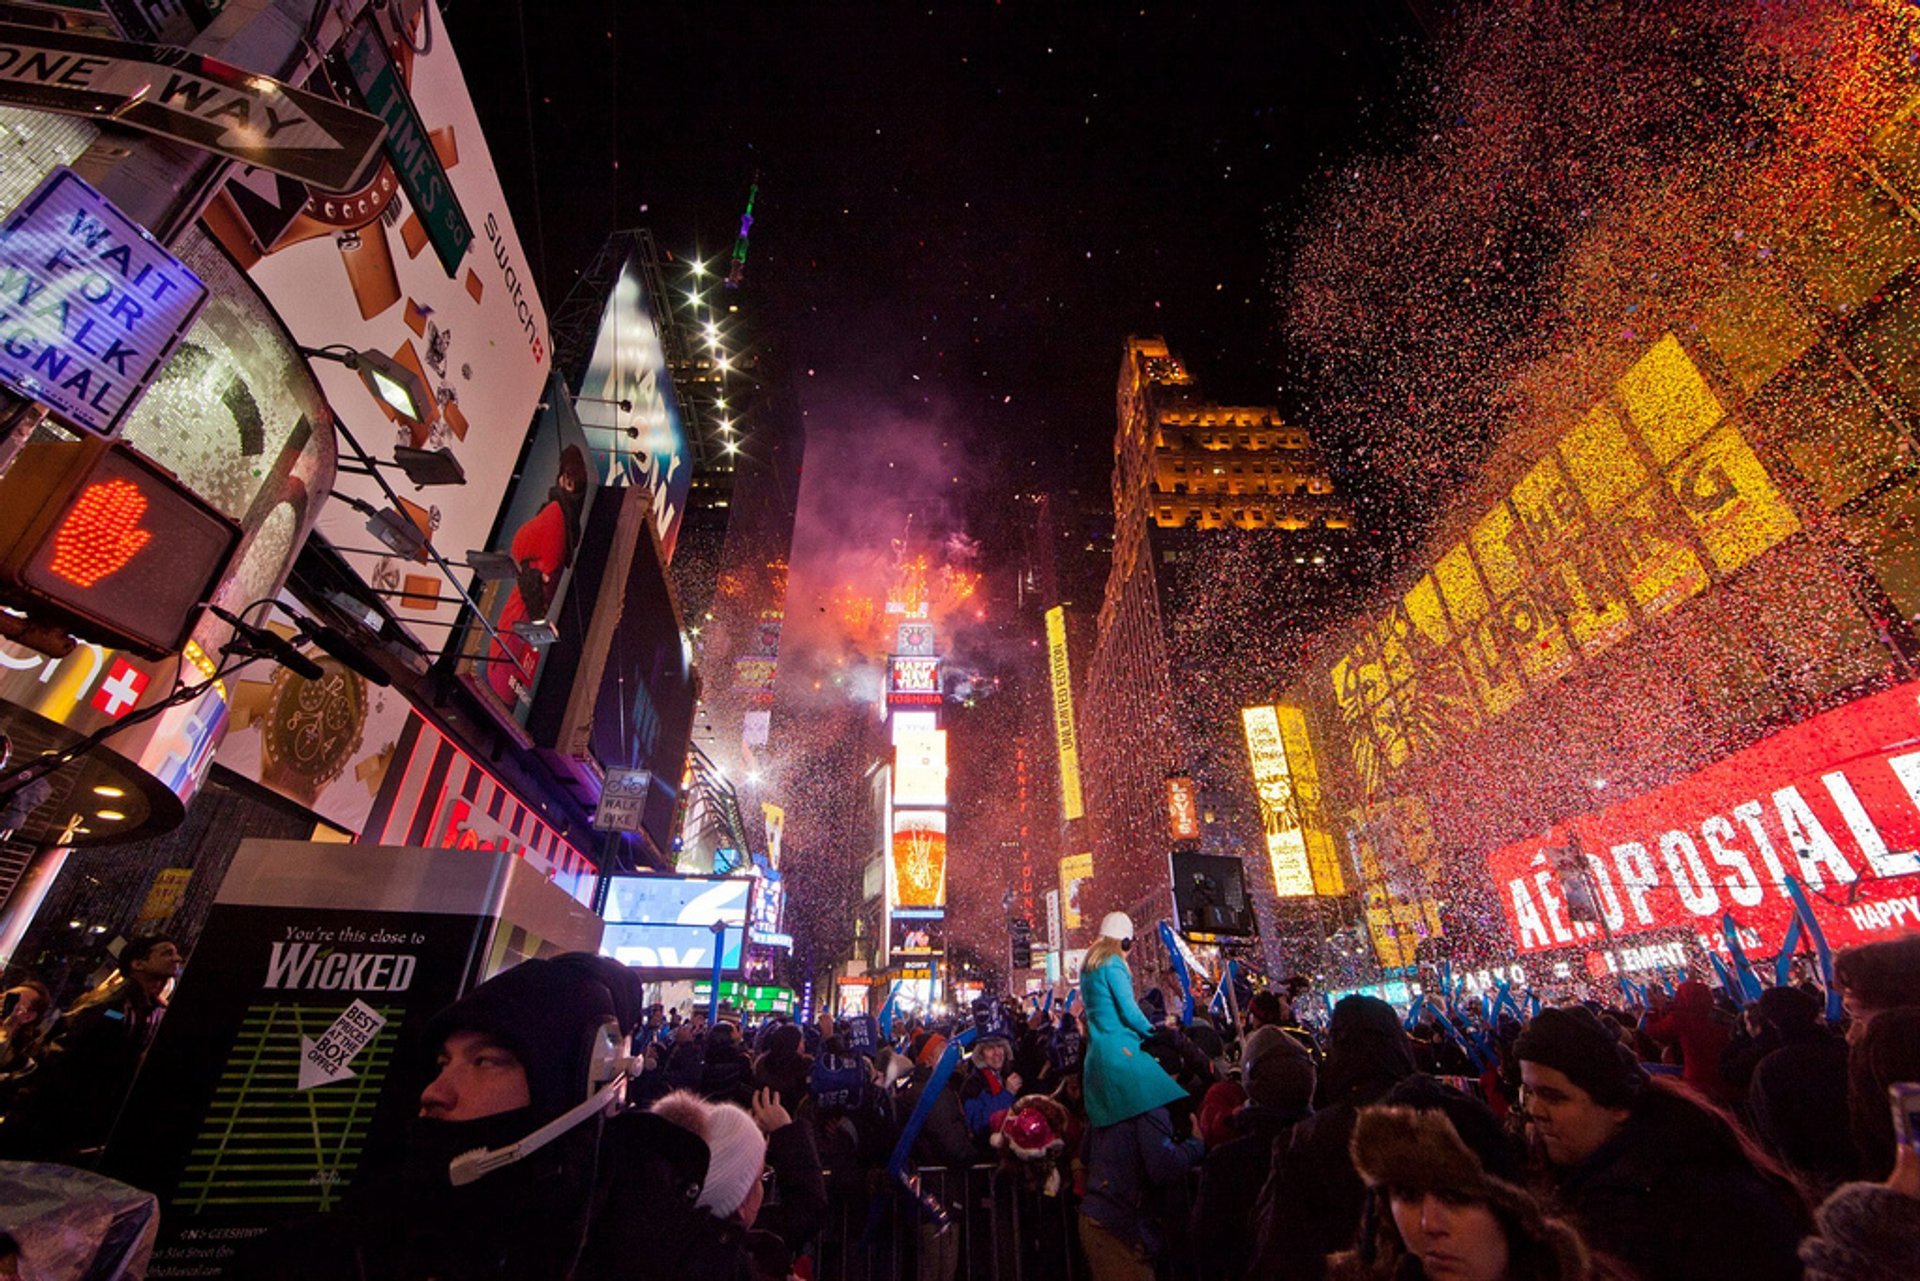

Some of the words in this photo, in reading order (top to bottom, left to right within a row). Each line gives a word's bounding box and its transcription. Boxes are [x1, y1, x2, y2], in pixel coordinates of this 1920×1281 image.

[159, 73, 307, 140] WAY
[379, 83, 442, 214] TIMES
[68, 207, 178, 302] WAIT
[45, 247, 144, 331] FOR
[484, 212, 536, 344] swatch
[0, 263, 140, 376] WALK
[0, 312, 111, 416] GNAL
[888, 694, 942, 704] TOSHIBA
[606, 799, 637, 811] WALK
[1509, 752, 1920, 950] AÉOPOSTAL
[1845, 896, 1920, 931] HAPPY
[285, 926, 334, 942] You're
[339, 926, 367, 943] this
[370, 928, 407, 944] close
[411, 932, 426, 945] to
[335, 1018, 369, 1044] PRICES
[345, 1005, 380, 1033] BEST
[315, 1037, 350, 1066] BOX
[327, 1029, 342, 1040] AT
[340, 1036, 360, 1053] THE
[307, 1050, 340, 1076] OFFICE
